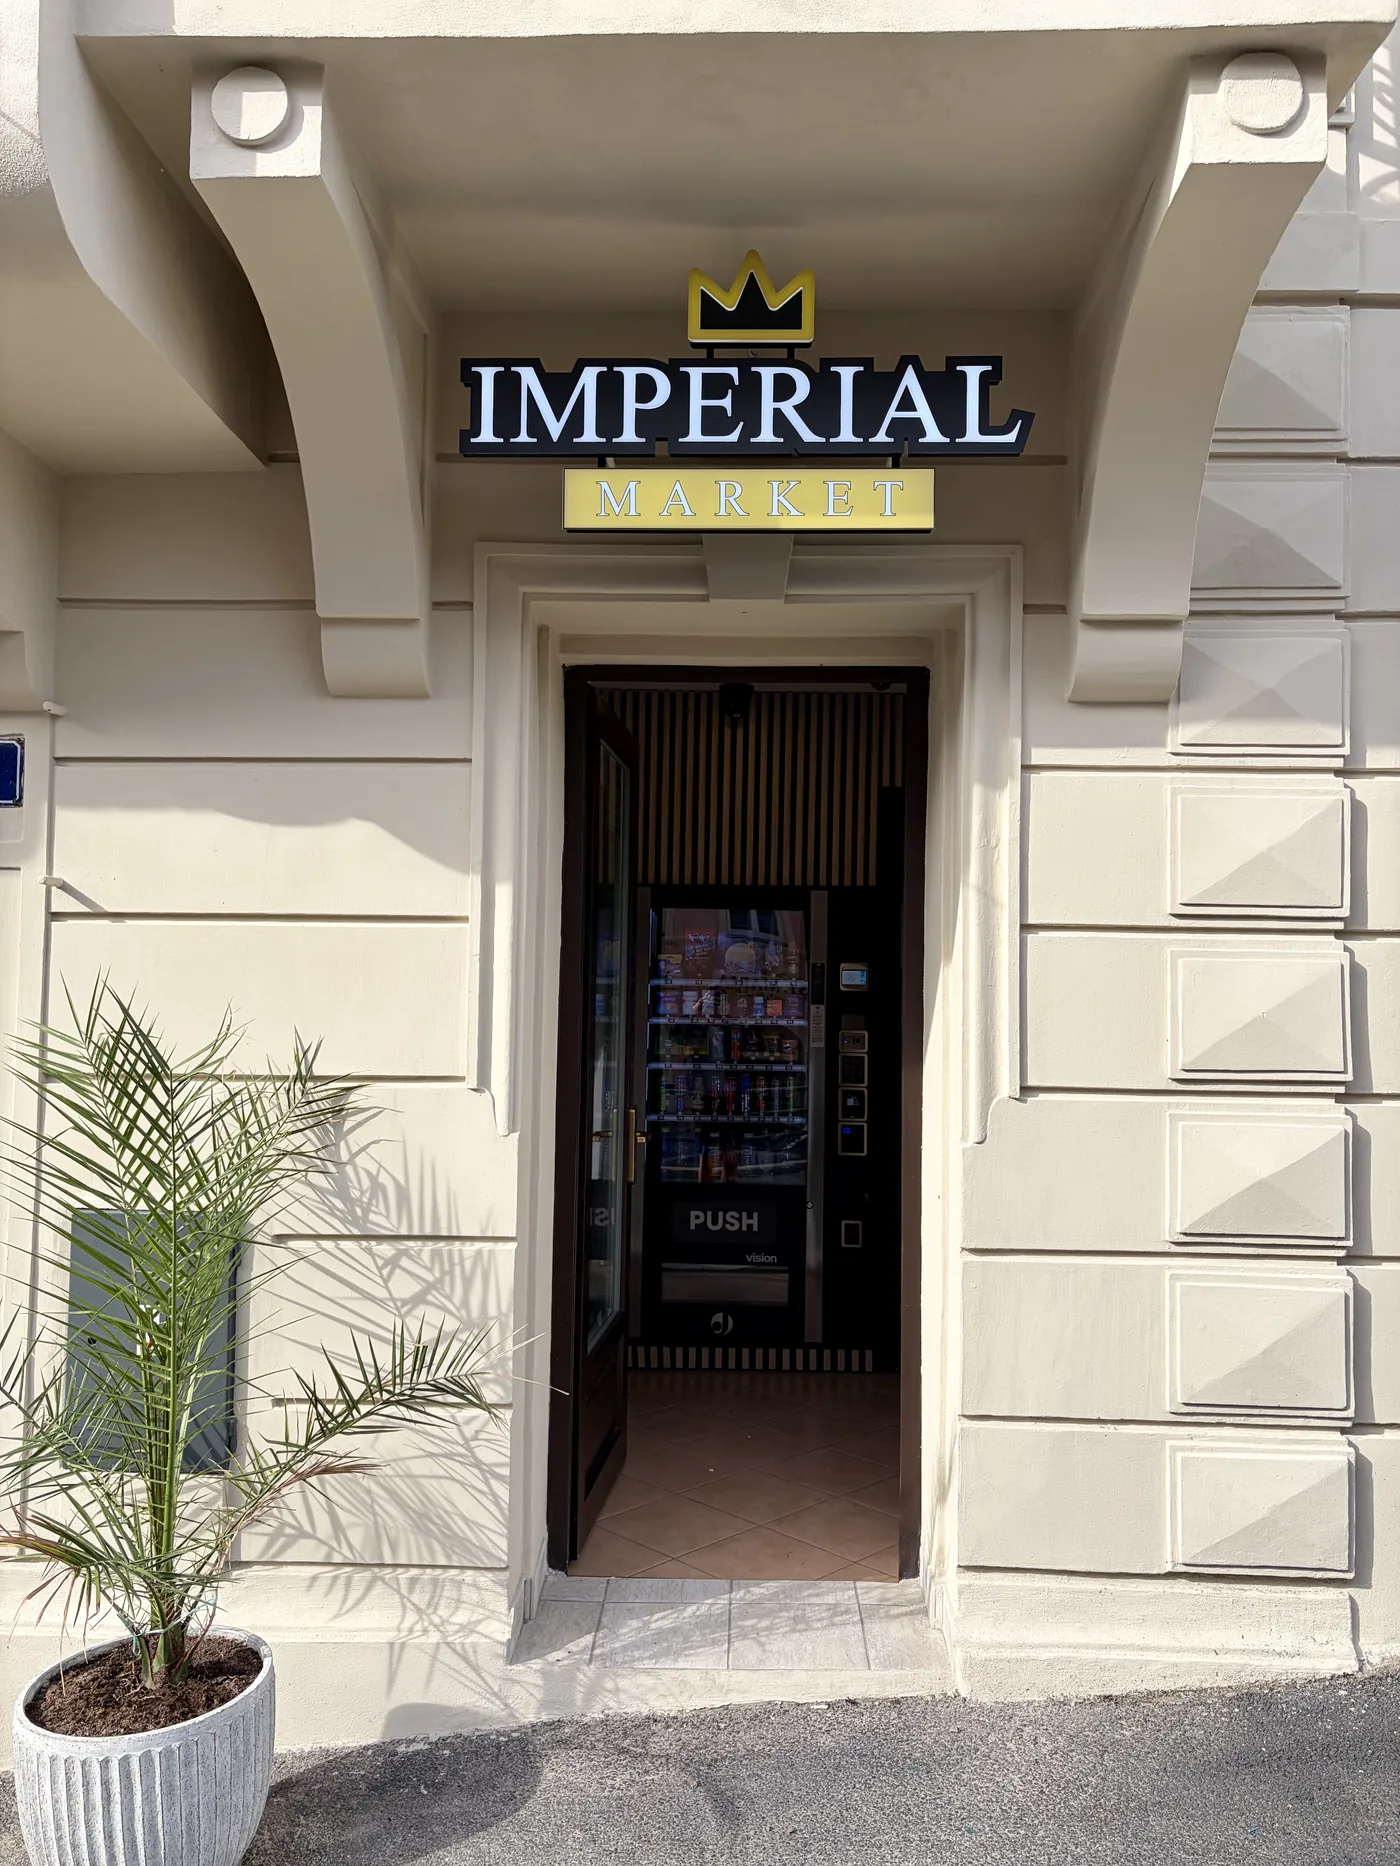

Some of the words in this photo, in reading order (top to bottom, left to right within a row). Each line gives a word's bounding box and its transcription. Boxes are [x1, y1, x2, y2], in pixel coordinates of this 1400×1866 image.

[469, 364, 1022, 443] IMPERIAL
[596, 481, 904, 517] MARKET
[689, 1210, 759, 1231] PUSH
[745, 1252, 778, 1263] vision
